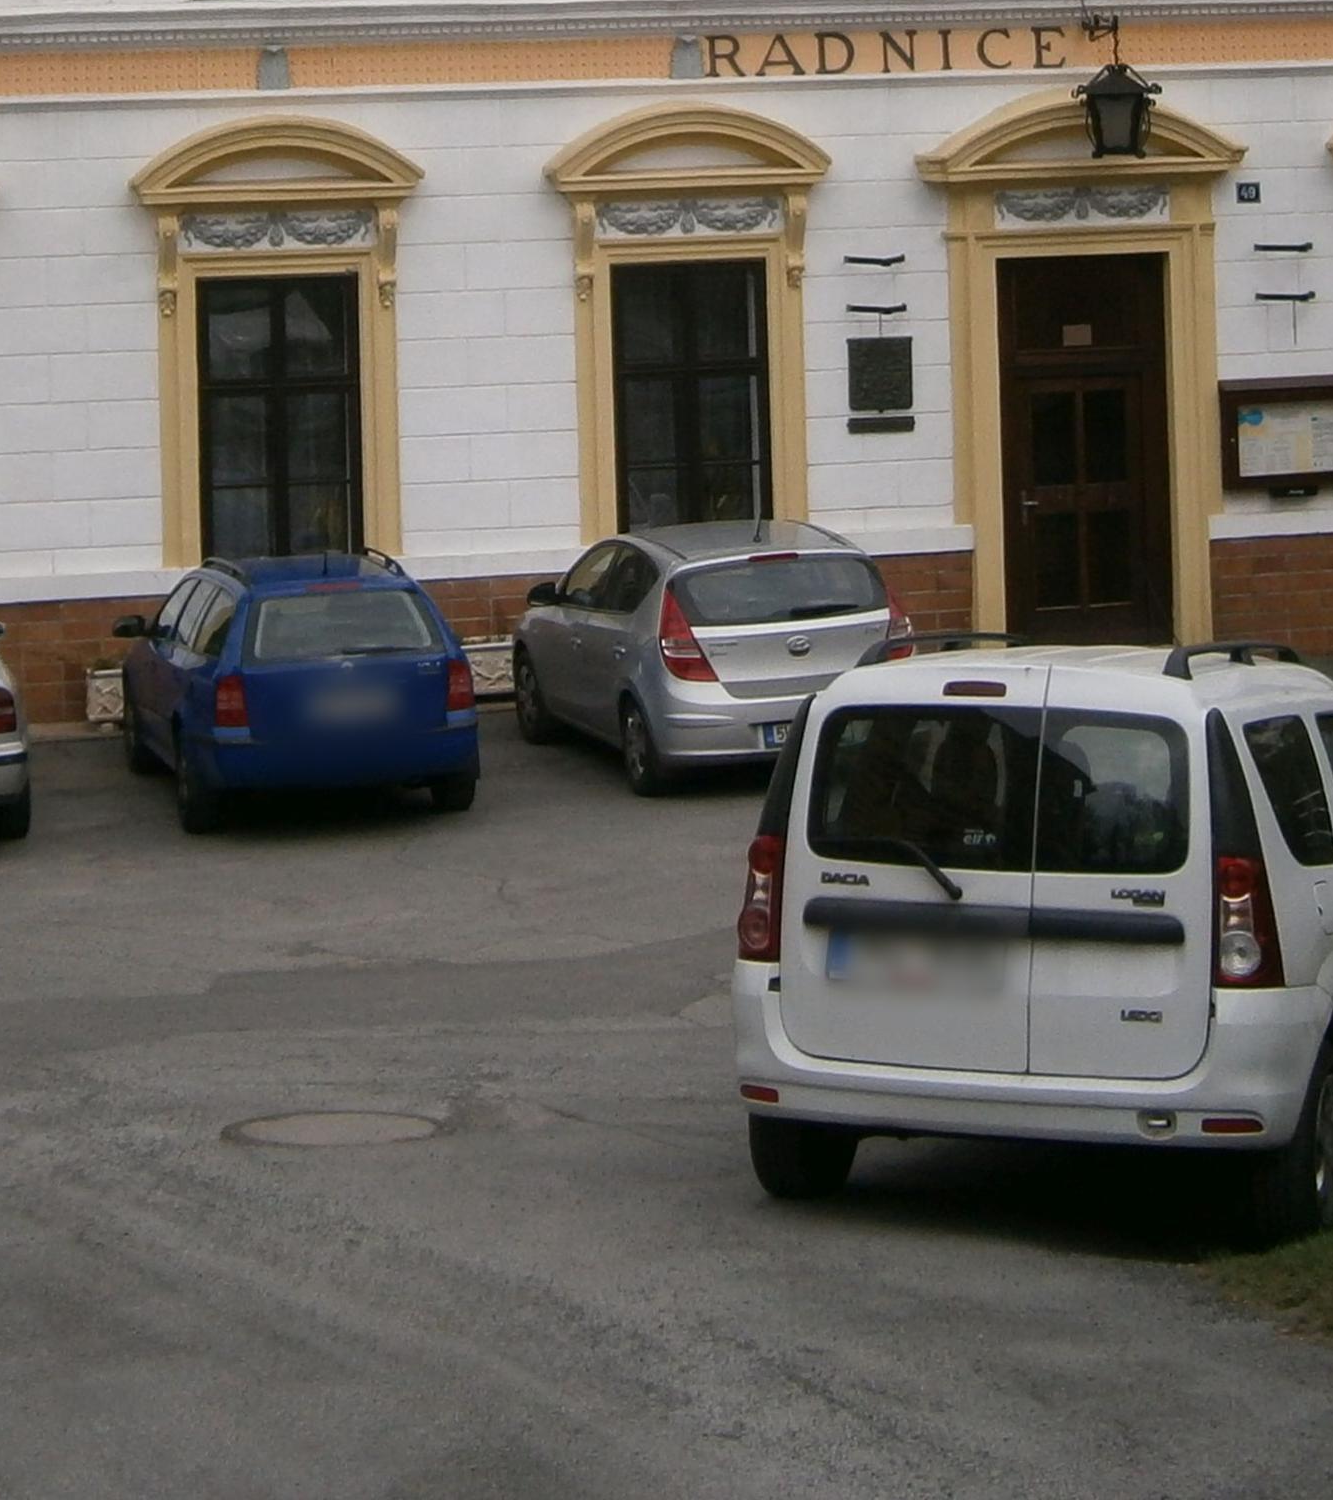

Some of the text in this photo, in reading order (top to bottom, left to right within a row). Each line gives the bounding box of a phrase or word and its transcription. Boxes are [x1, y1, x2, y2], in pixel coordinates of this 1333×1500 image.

[704, 25, 1067, 77] RADNICE
[821, 871, 870, 887] DACIA
[1110, 888, 1166, 901] LOGAN
